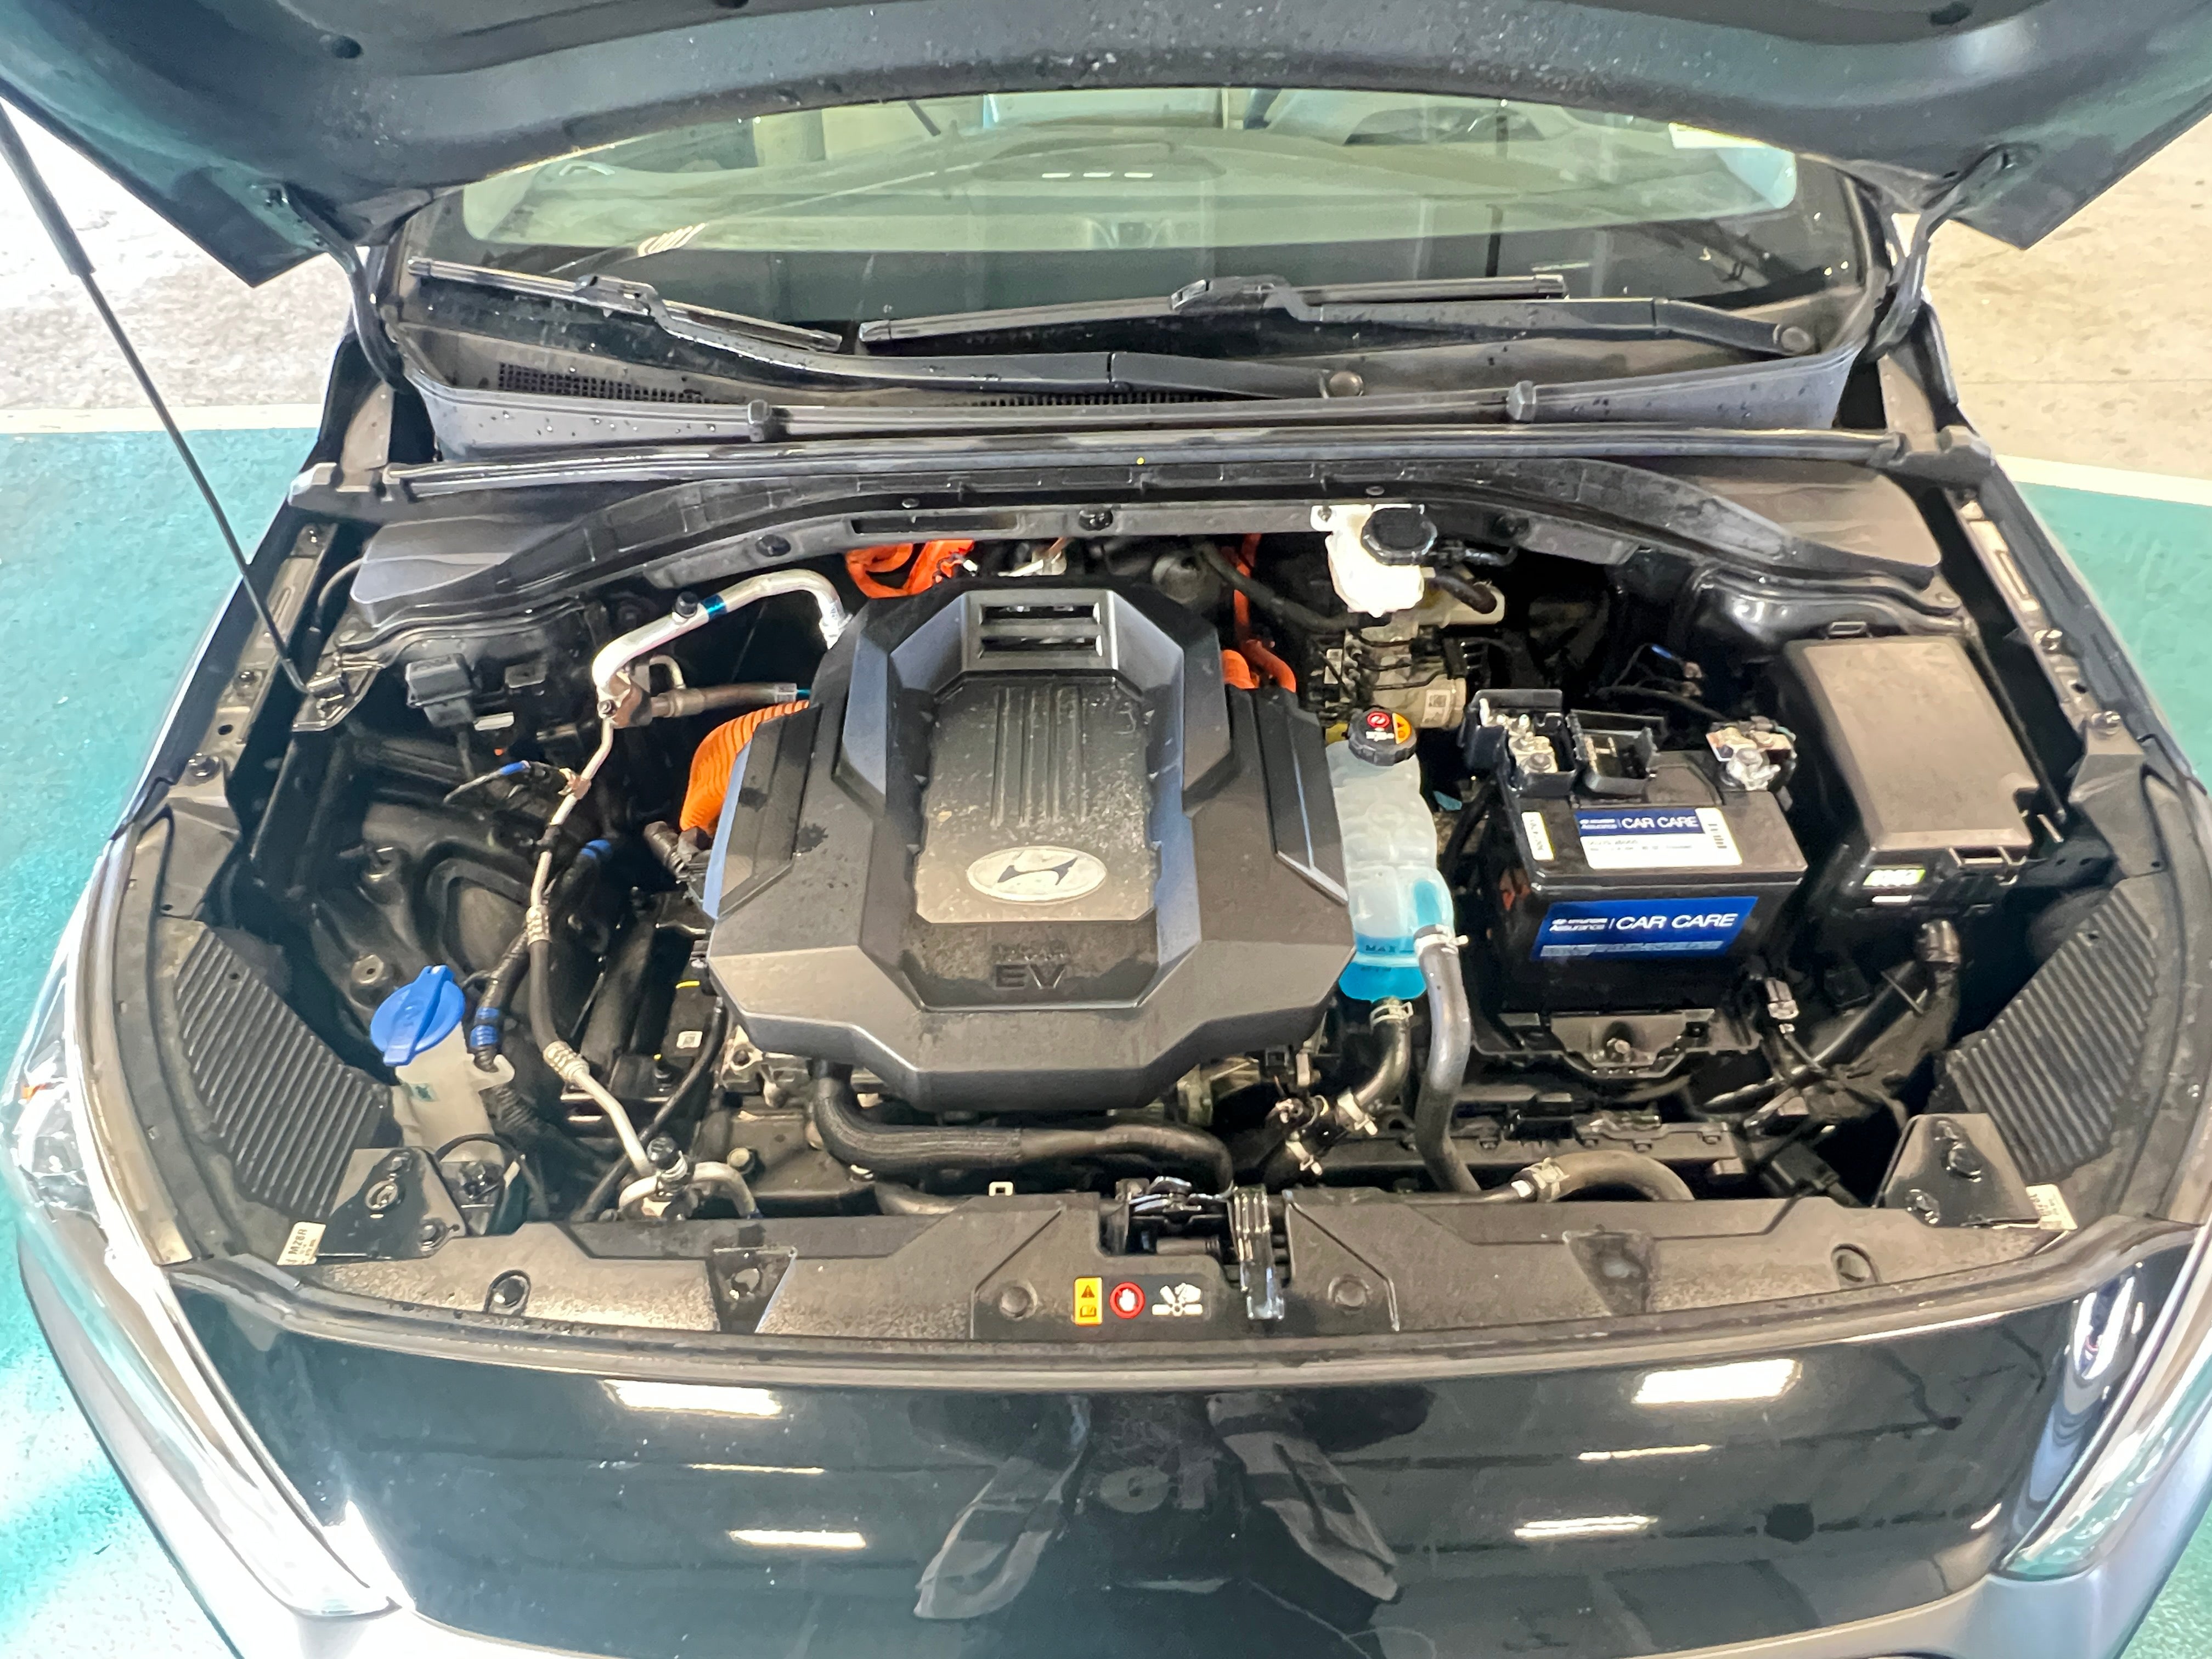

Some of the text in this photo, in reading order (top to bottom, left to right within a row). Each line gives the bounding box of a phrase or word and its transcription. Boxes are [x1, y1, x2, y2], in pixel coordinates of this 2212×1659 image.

[1622, 817, 1655, 830] CAR
[1657, 816, 1700, 828] CARE
[1616, 915, 1667, 930] CAR
[1671, 913, 1739, 930] CARE
[995, 964, 1066, 989] EV
